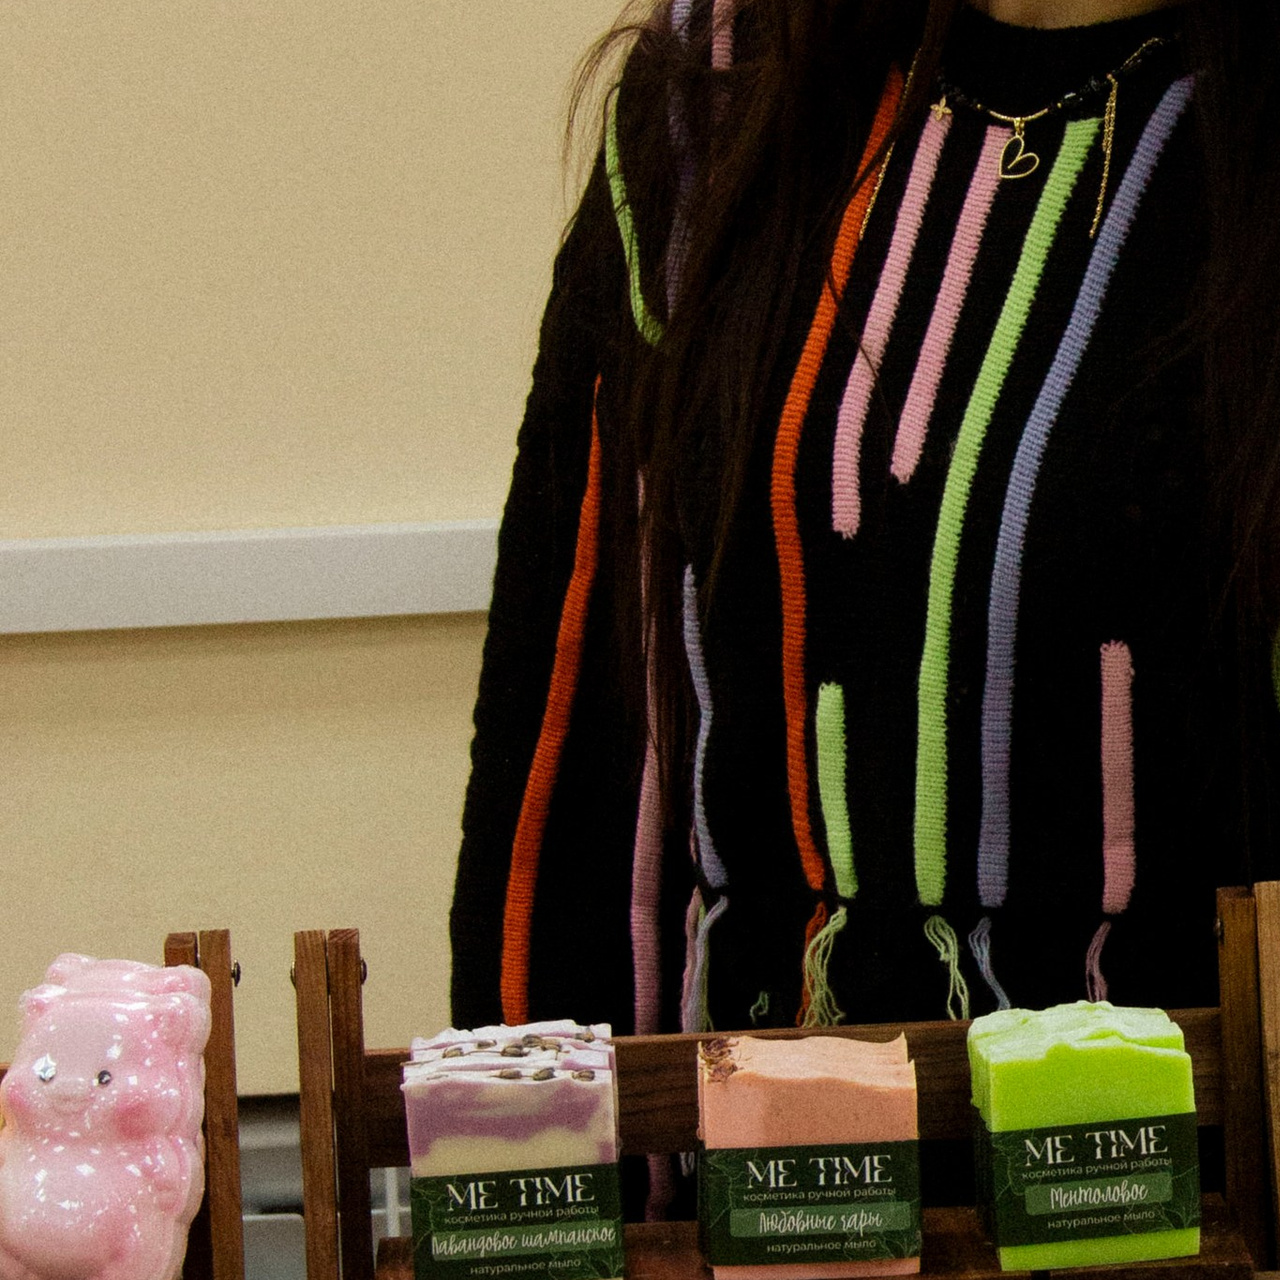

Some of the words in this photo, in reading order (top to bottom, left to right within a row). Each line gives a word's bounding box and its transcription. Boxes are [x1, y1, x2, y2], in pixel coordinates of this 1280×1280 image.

[1023, 1134, 1075, 1167] ME
[1085, 1124, 1169, 1160] TIME
[745, 1159, 798, 1189] ME
[808, 1154, 893, 1186] TIME
[1021, 1166, 1083, 1180] косметика
[1085, 1160, 1128, 1175] ручной
[1130, 1157, 1173, 1171] работы
[446, 1180, 499, 1212] ME
[509, 1173, 595, 1207] TIME
[743, 1190, 805, 1202] косметика
[807, 1188, 850, 1202] ручной
[853, 1185, 896, 1198] работы
[1050, 1179, 1149, 1210] Ментоловое
[444, 1212, 507, 1225] косметика
[556, 1204, 600, 1218] работы
[759, 1210, 836, 1234] Любовные
[1048, 1214, 1121, 1230] натуральное
[1123, 1210, 1156, 1221] мыло
[766, 1241, 841, 1254] натуральное
[844, 1239, 876, 1250] мыло
[470, 1260, 545, 1276] натуральное
[548, 1258, 582, 1270] мыло
